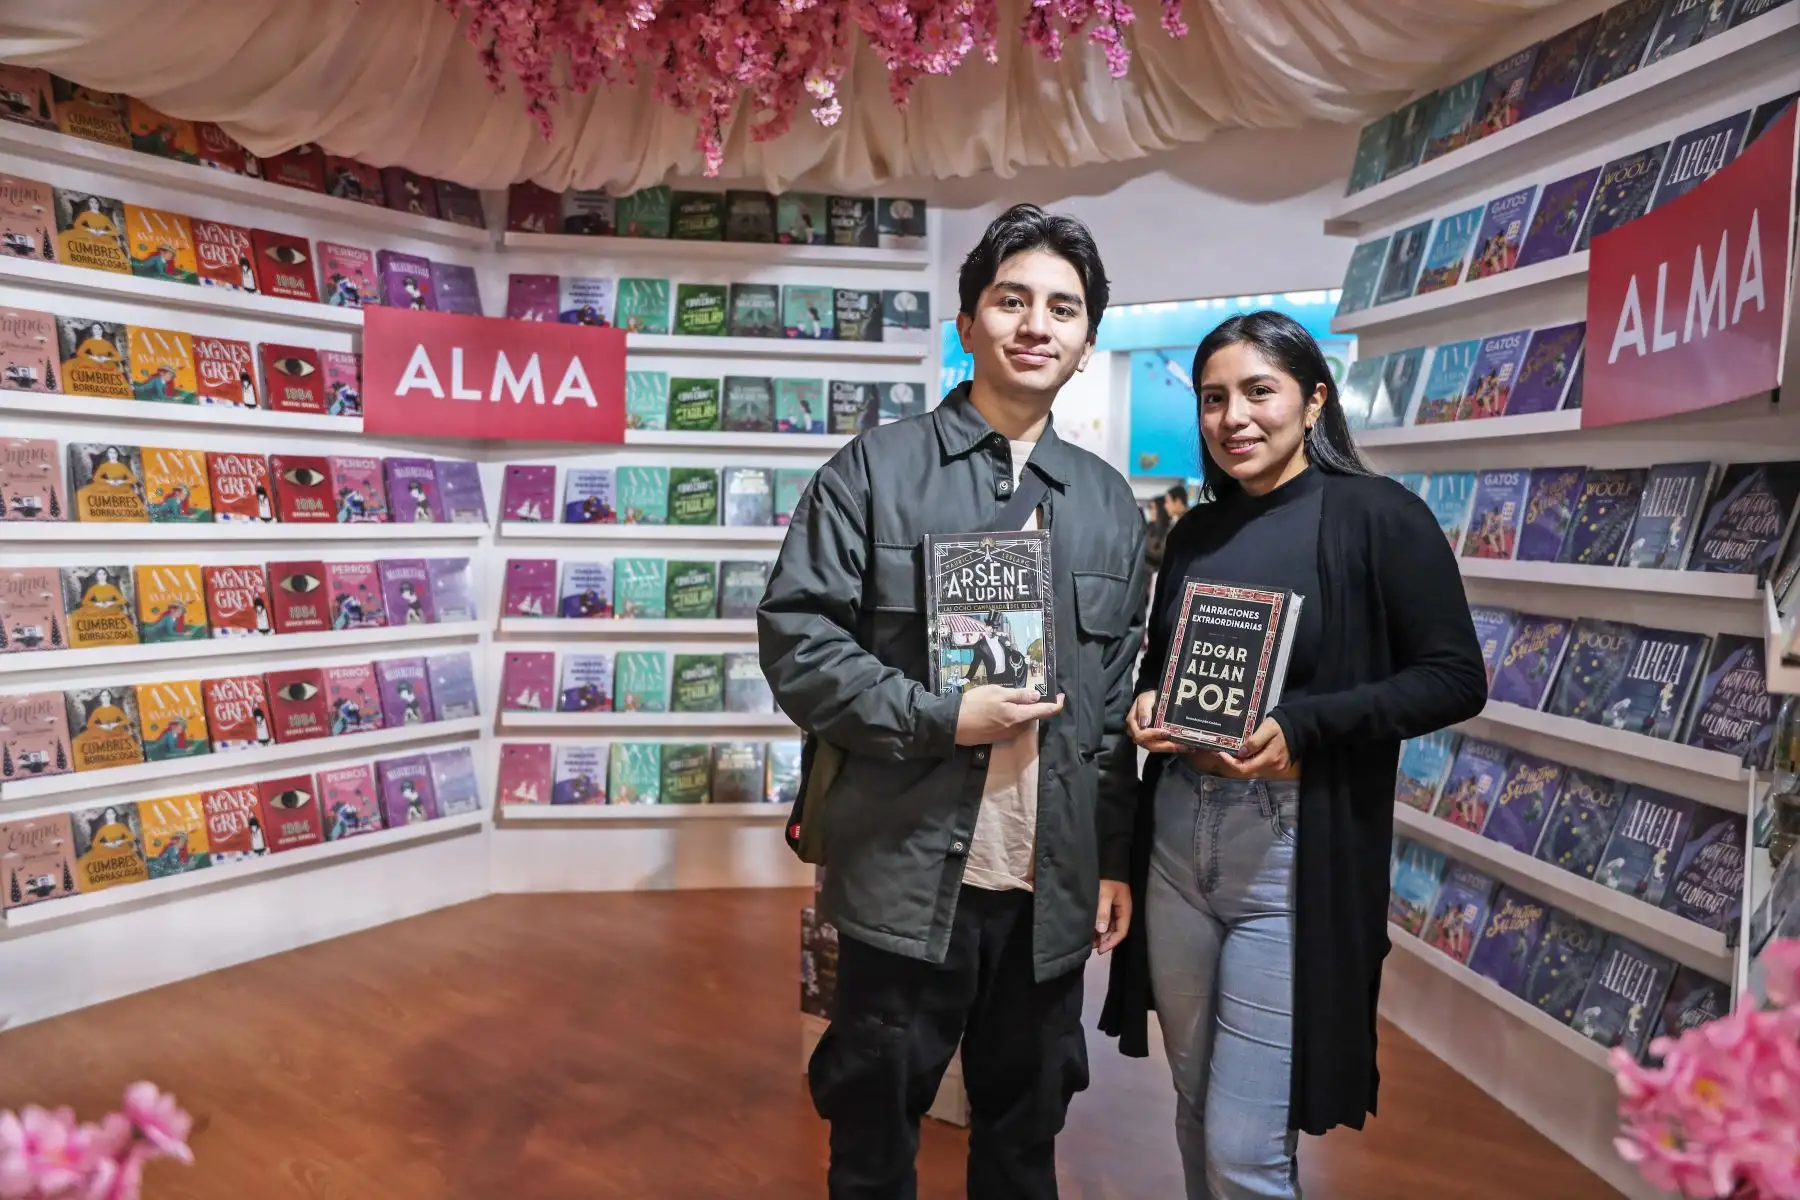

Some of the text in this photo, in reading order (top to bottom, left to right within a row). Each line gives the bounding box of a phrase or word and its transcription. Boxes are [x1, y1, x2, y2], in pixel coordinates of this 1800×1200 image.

[1604, 156, 1658, 186] WOOLF
[1491, 192, 1528, 214] GATOS
[196, 223, 250, 249] AGNES
[68, 240, 122, 260] CUMBRES
[199, 242, 241, 268] GREY
[1607, 208, 1766, 365] ALMA
[194, 340, 250, 363] AGNES
[1485, 335, 1521, 352] GATOS
[71, 370, 124, 387] CUMBRES
[199, 360, 243, 387] GREY
[394, 343, 598, 407] ALMA
[214, 455, 266, 477] AGNES
[216, 475, 257, 503] GREY
[1484, 472, 1520, 486] GATOS
[88, 495, 138, 508] CUMBRES
[211, 568, 262, 588] AGNES
[215, 588, 256, 617] GREY
[966, 586, 1014, 602] LUPIN
[1191, 614, 1263, 631] EXTRAORDINARIAS
[1199, 603, 1260, 620] NARRACIONES
[76, 617, 128, 633] CUMBRES
[1192, 641, 1248, 663] EDGAR
[1627, 640, 1690, 685] ALICIA
[1186, 658, 1245, 683] ALLAN
[211, 678, 263, 699] AGNES
[1174, 677, 1245, 717] POE
[215, 698, 257, 730] GREY
[1730, 692, 1771, 719] LOCURA
[80, 740, 133, 756] CUMBRES
[207, 788, 258, 813] AGNES
[209, 808, 251, 843] GREY
[1622, 799, 1683, 852] ALICIA
[87, 855, 138, 875] CUMBRES
